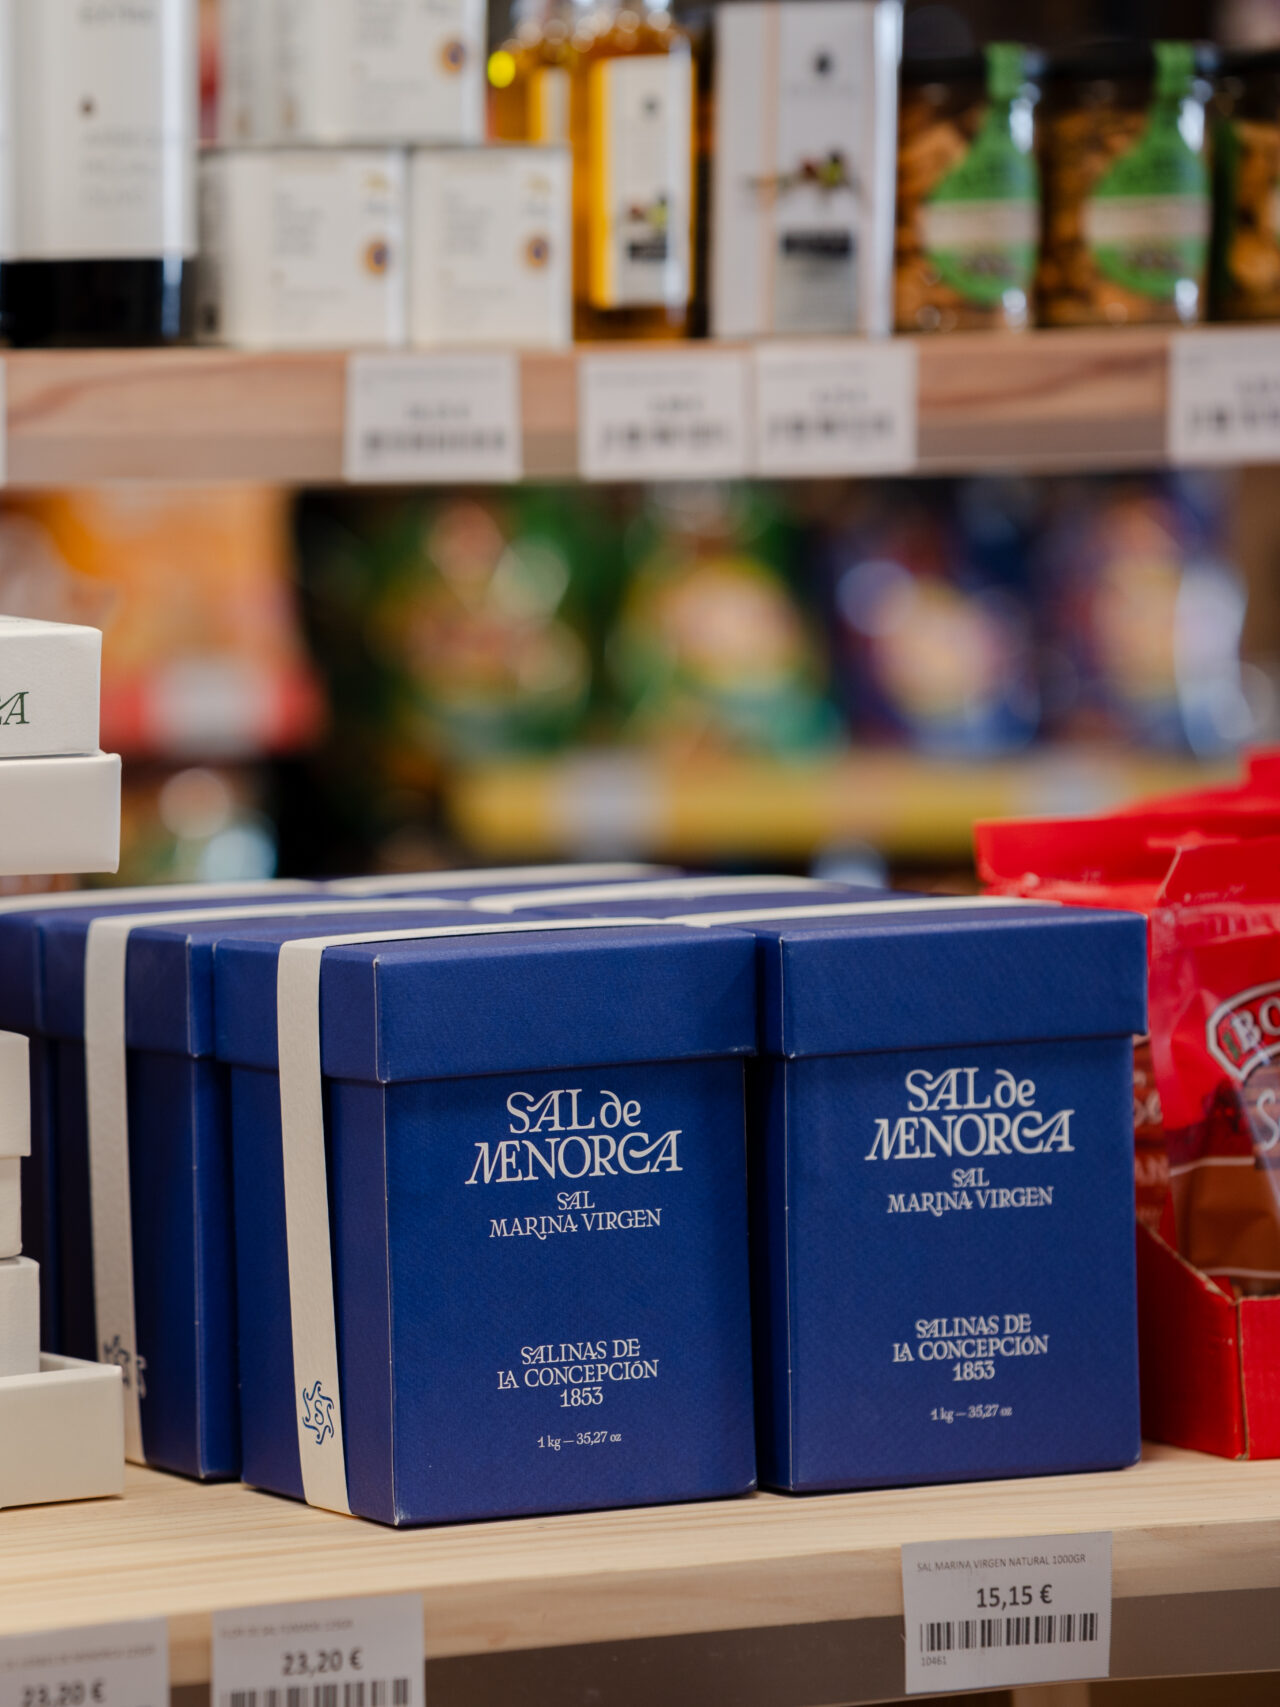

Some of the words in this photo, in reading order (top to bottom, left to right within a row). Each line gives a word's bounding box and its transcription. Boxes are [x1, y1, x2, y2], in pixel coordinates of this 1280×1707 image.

[906, 1068, 991, 1112] SAL
[995, 1070, 1035, 1108] de
[507, 1089, 595, 1133] SAL
[600, 1090, 641, 1127] de
[865, 1109, 1074, 1160] MENORCA
[465, 1129, 683, 1184] MENORCA
[951, 1168, 990, 1188] SAL
[557, 1191, 595, 1210] SAL
[888, 1191, 972, 1216] MARINA
[976, 1186, 1053, 1209] VIRGEN
[489, 1214, 578, 1240] MARINA
[582, 1208, 662, 1232] VIRGEN
[915, 1316, 999, 1339] SALINAS
[1004, 1313, 1031, 1334] DE
[520, 1341, 608, 1365] SALINAS
[612, 1338, 640, 1358] DE
[893, 1343, 913, 1363] LA
[497, 1371, 519, 1389] LA
[952, 1361, 995, 1382] 1853
[561, 1387, 603, 1407] 1853
[931, 1409, 938, 1420] 1
[941, 1408, 953, 1423] kg
[967, 1404, 999, 1420] 35,27
[1000, 1408, 1012, 1416] oz
[537, 1437, 545, 1447] 1
[548, 1435, 561, 1451] kg
[577, 1431, 607, 1445] 35,27
[610, 1434, 621, 1442] oz
[917, 1561, 932, 1573] SAL
[935, 1560, 971, 1571] MARINA
[973, 1558, 1007, 1569] VIRGEN
[1009, 1555, 1050, 1566] NATURAL
[1052, 1553, 1087, 1565] 1000GR
[977, 1586, 1032, 1610] 15,15
[1040, 1584, 1052, 1604] €
[282, 1649, 343, 1678] 23,20
[349, 1648, 362, 1671] €
[922, 1656, 946, 1666] 10461
